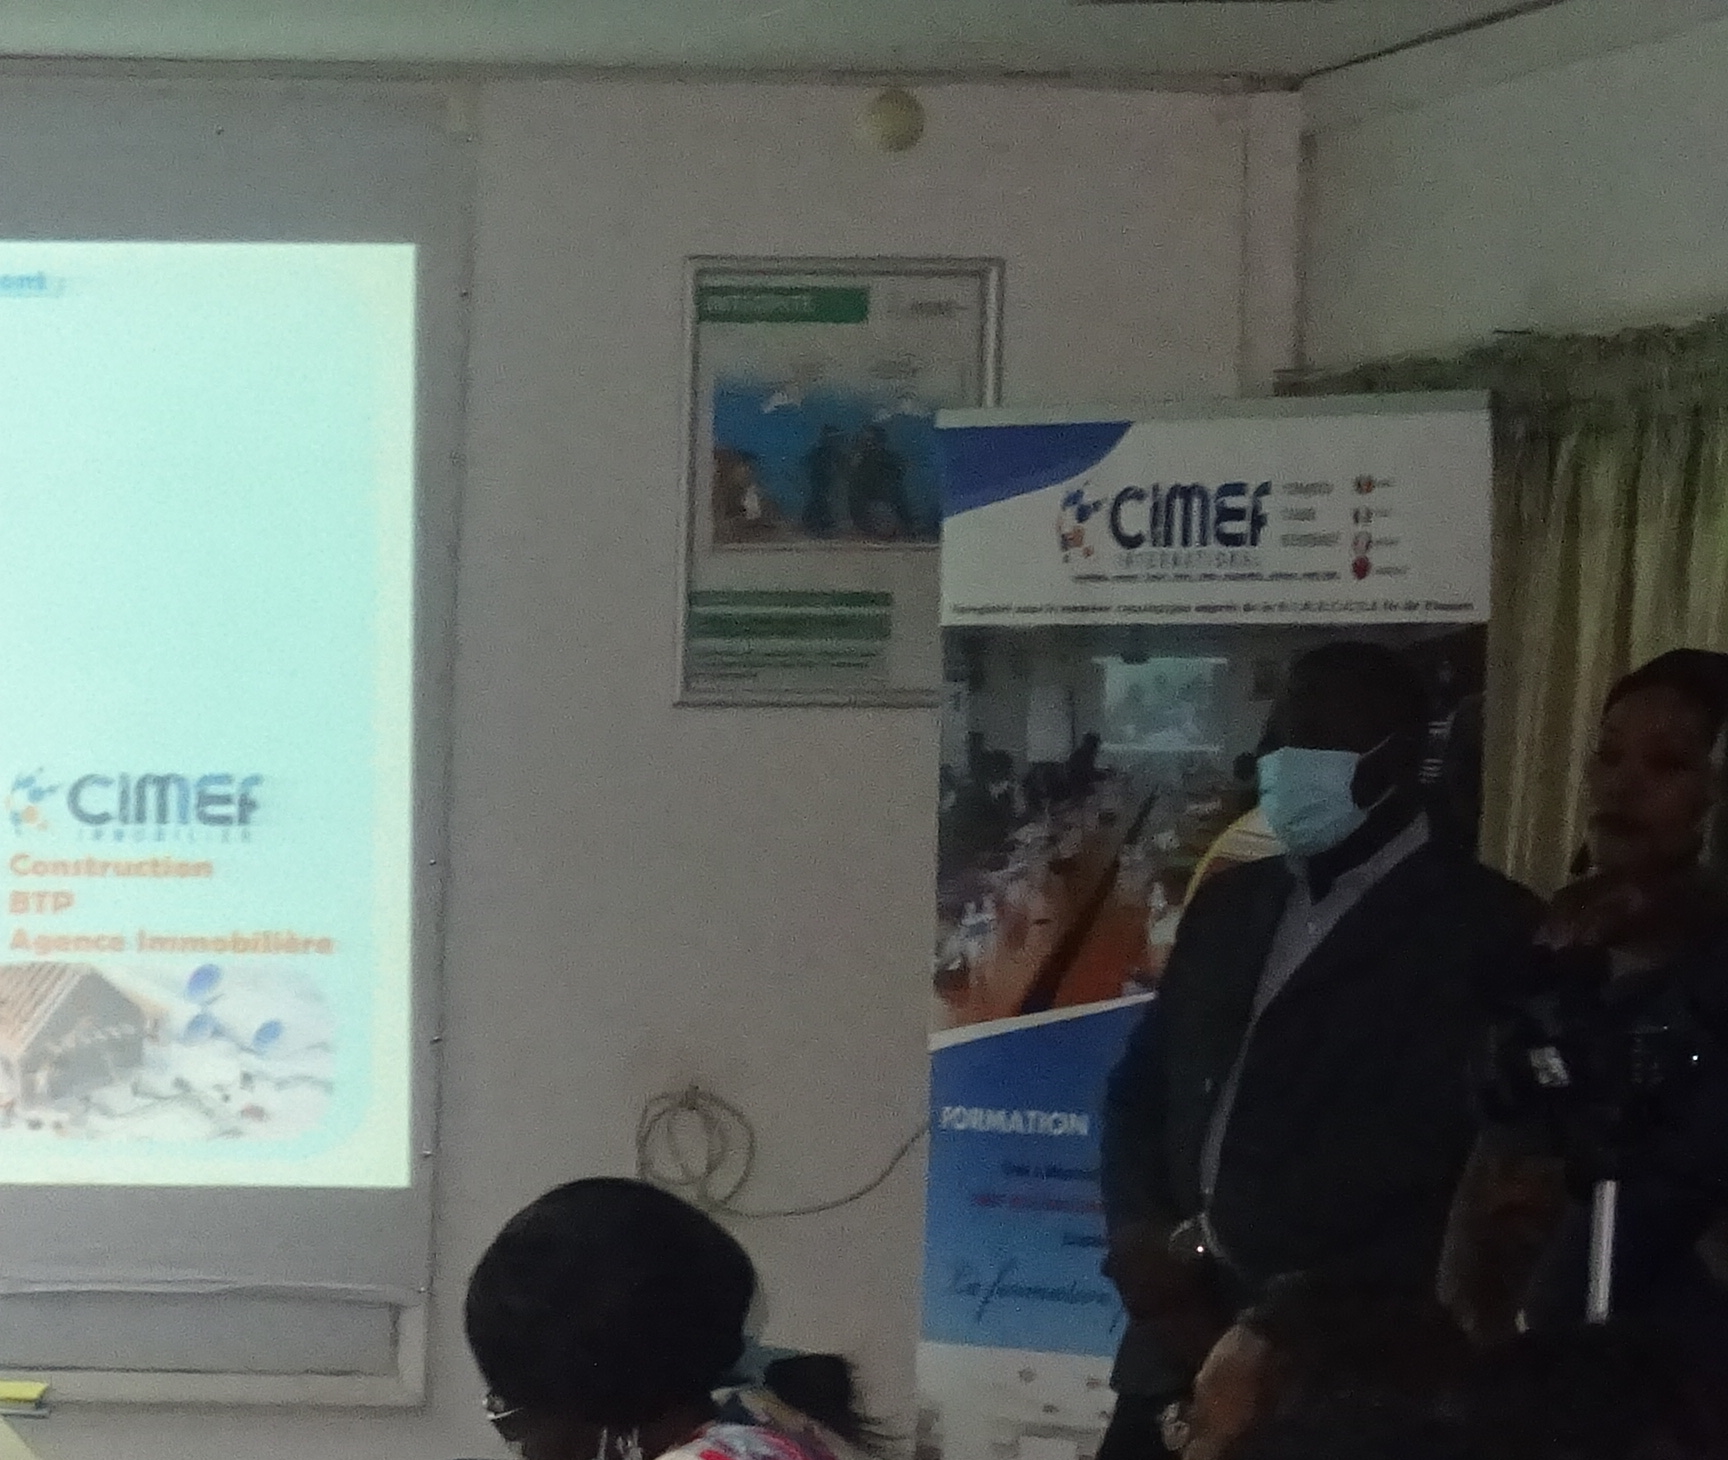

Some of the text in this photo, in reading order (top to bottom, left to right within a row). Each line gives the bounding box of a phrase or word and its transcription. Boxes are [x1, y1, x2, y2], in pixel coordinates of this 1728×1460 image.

[1109, 480, 1272, 550] CIMEF
[66, 772, 263, 826] CIMEF
[9, 853, 214, 878] Construction
[9, 890, 75, 914] BTP
[9, 928, 334, 955] Agence Immobilière
[941, 1105, 1091, 1136] FORMATION
